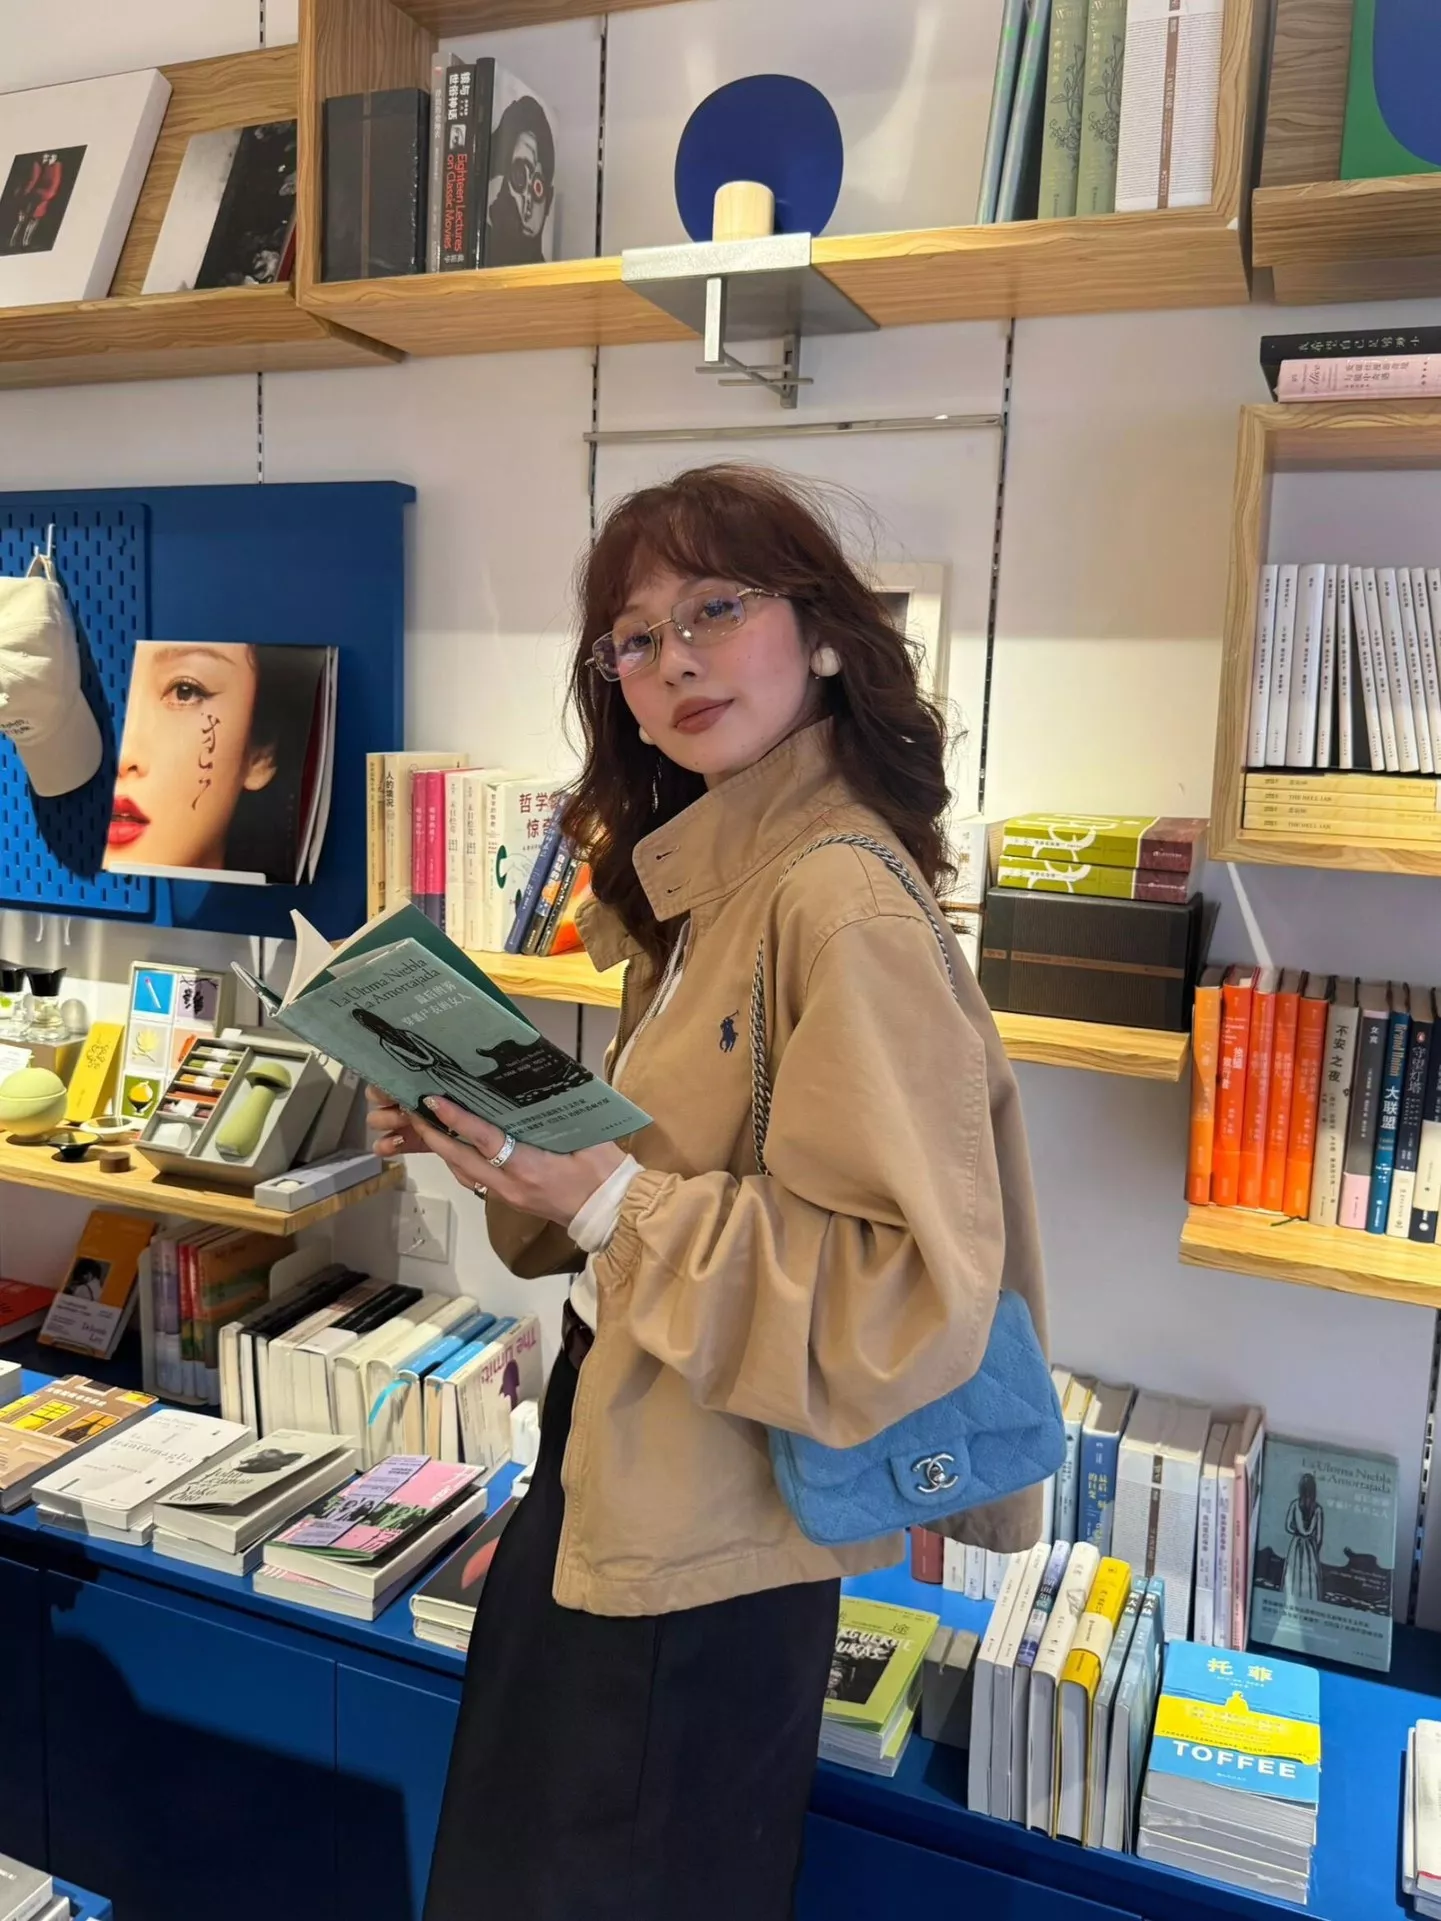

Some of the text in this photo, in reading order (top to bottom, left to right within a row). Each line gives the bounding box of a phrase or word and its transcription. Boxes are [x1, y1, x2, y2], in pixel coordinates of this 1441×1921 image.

[447, 73, 460, 120] 世俗神话
[443, 154, 456, 249] on Classic Movies
[453, 153, 468, 252] Eighteen Lectures
[371, 968, 441, 1006] Amortajada
[383, 958, 428, 983] Niebla
[1327, 1025, 1349, 1083] 不安之夜
[1407, 1046, 1427, 1094] 守望灯塔
[1380, 1085, 1401, 1130] 大联盟
[1206, 1657, 1274, 1683] 托菲
[1172, 1740, 1297, 1780] TOFFEE
